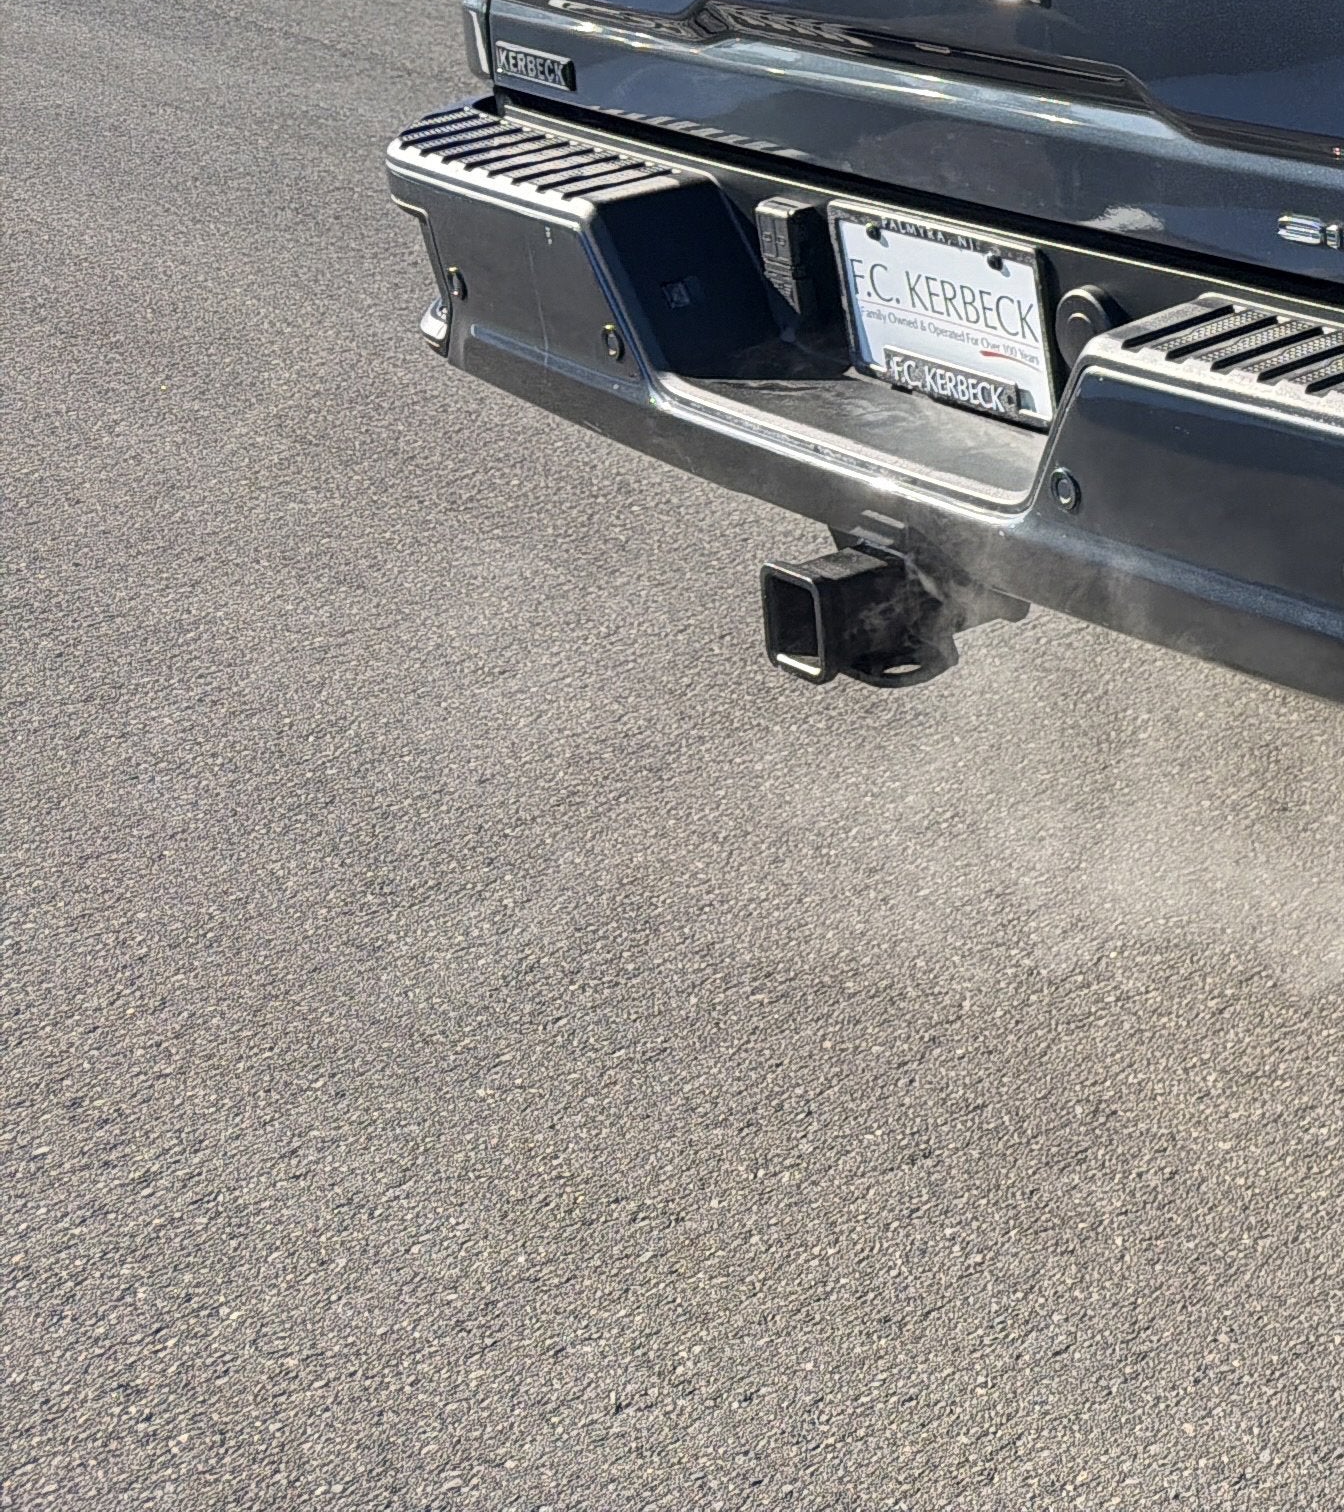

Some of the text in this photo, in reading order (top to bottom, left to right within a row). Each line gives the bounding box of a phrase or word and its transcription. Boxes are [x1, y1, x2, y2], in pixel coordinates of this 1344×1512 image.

[495, 46, 567, 87] KERBECK
[850, 258, 1040, 344] F.C. KERBECK
[888, 312, 918, 330] Owned
[928, 322, 965, 343] Operated
[966, 332, 979, 347] For
[980, 337, 1001, 352] Over
[924, 365, 1006, 413] KERBECK
